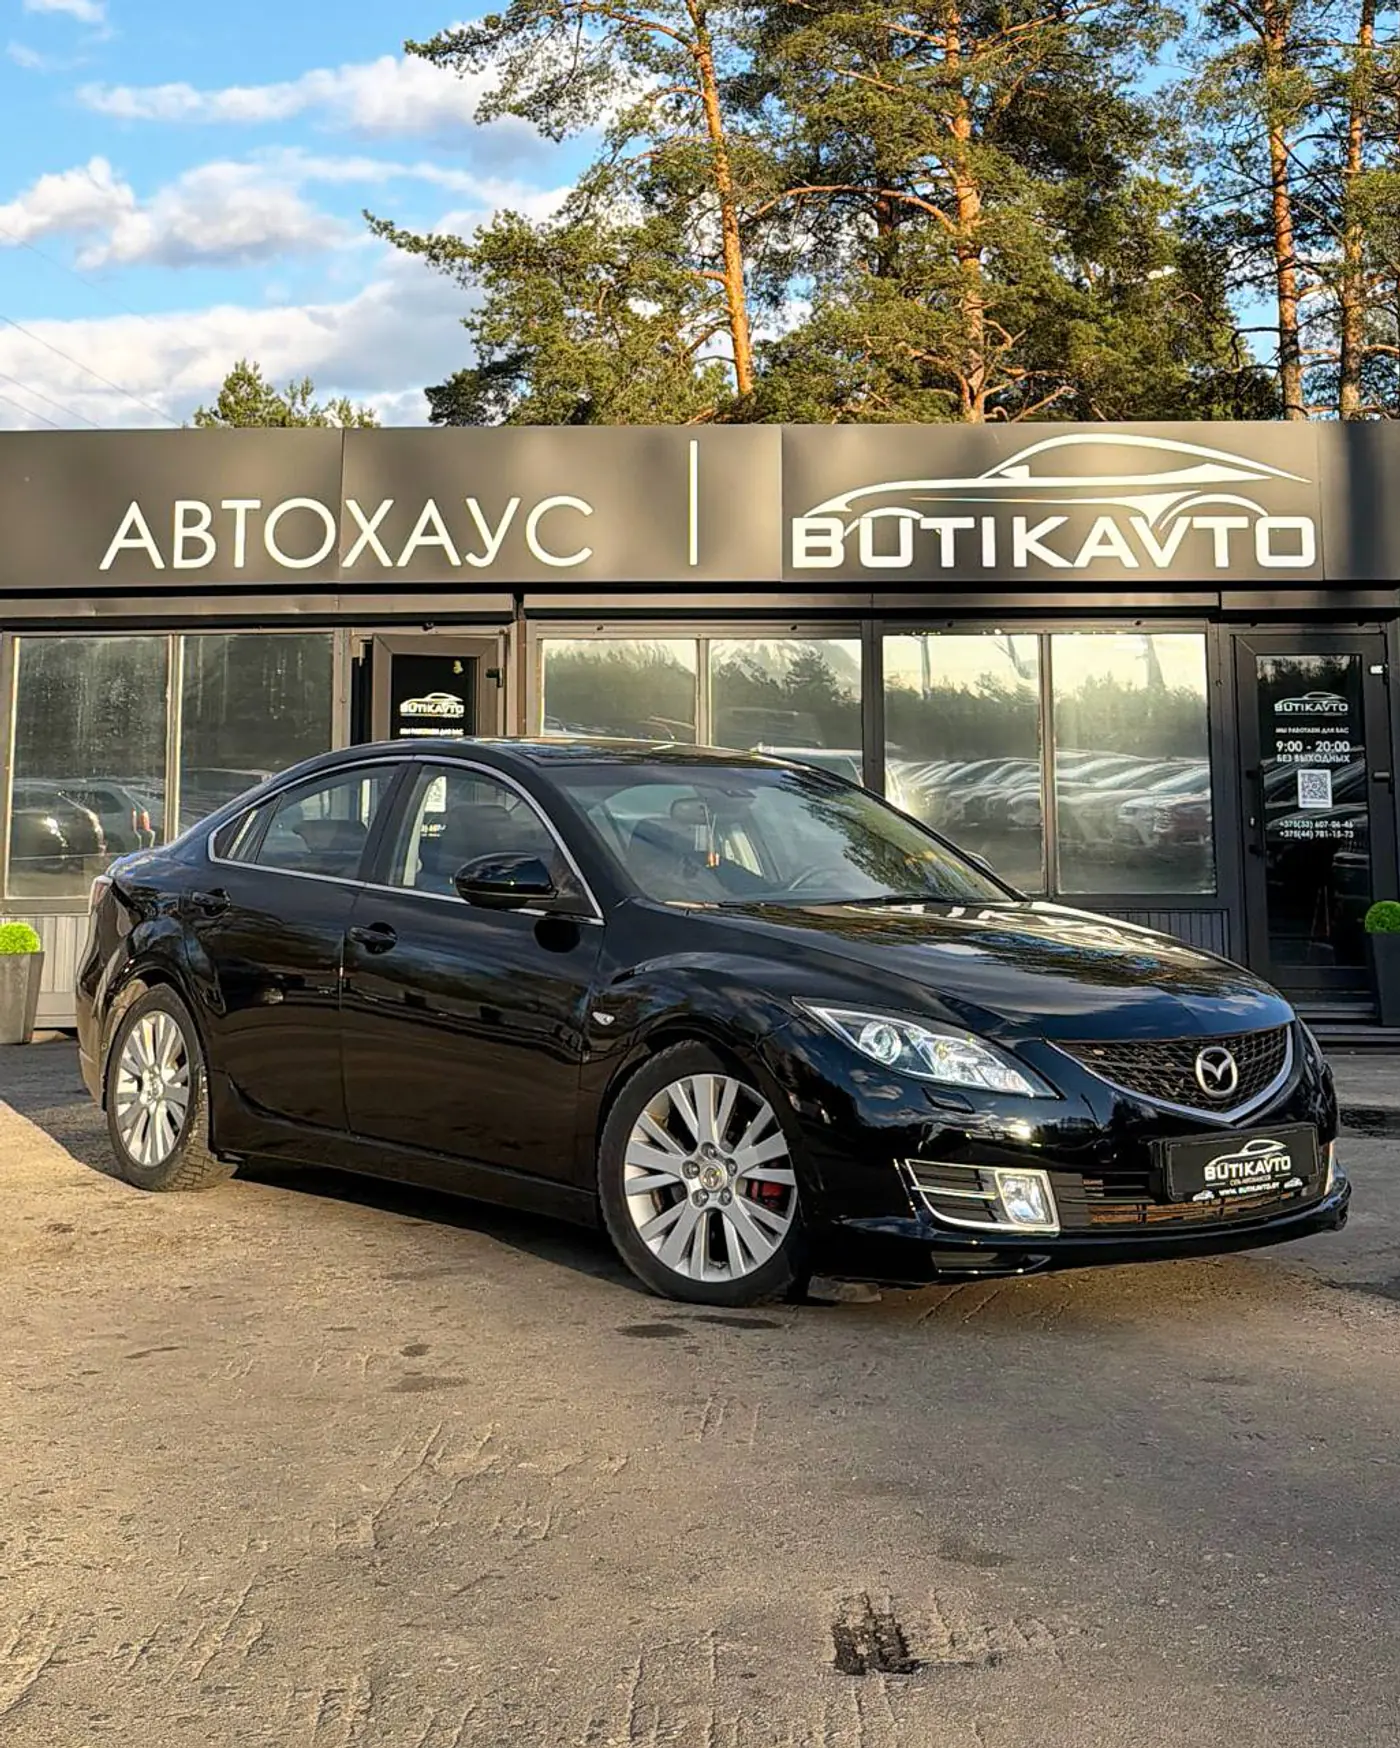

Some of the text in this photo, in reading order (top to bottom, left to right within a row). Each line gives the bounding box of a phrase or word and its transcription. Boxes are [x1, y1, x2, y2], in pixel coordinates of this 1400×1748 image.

[99, 496, 593, 570] АВТОХАУС
[792, 515, 1316, 569] BUTIKAVTO
[400, 702, 464, 713] BUTIKAVTO
[1274, 702, 1349, 712] BUTIKAVTO
[1276, 740, 1303, 753] 9:00
[1315, 740, 1350, 753] 20:00
[1276, 754, 1351, 764] БЕЗ ВЫХОДНЫХ
[1204, 1155, 1291, 1181] BUTIKAVTO
